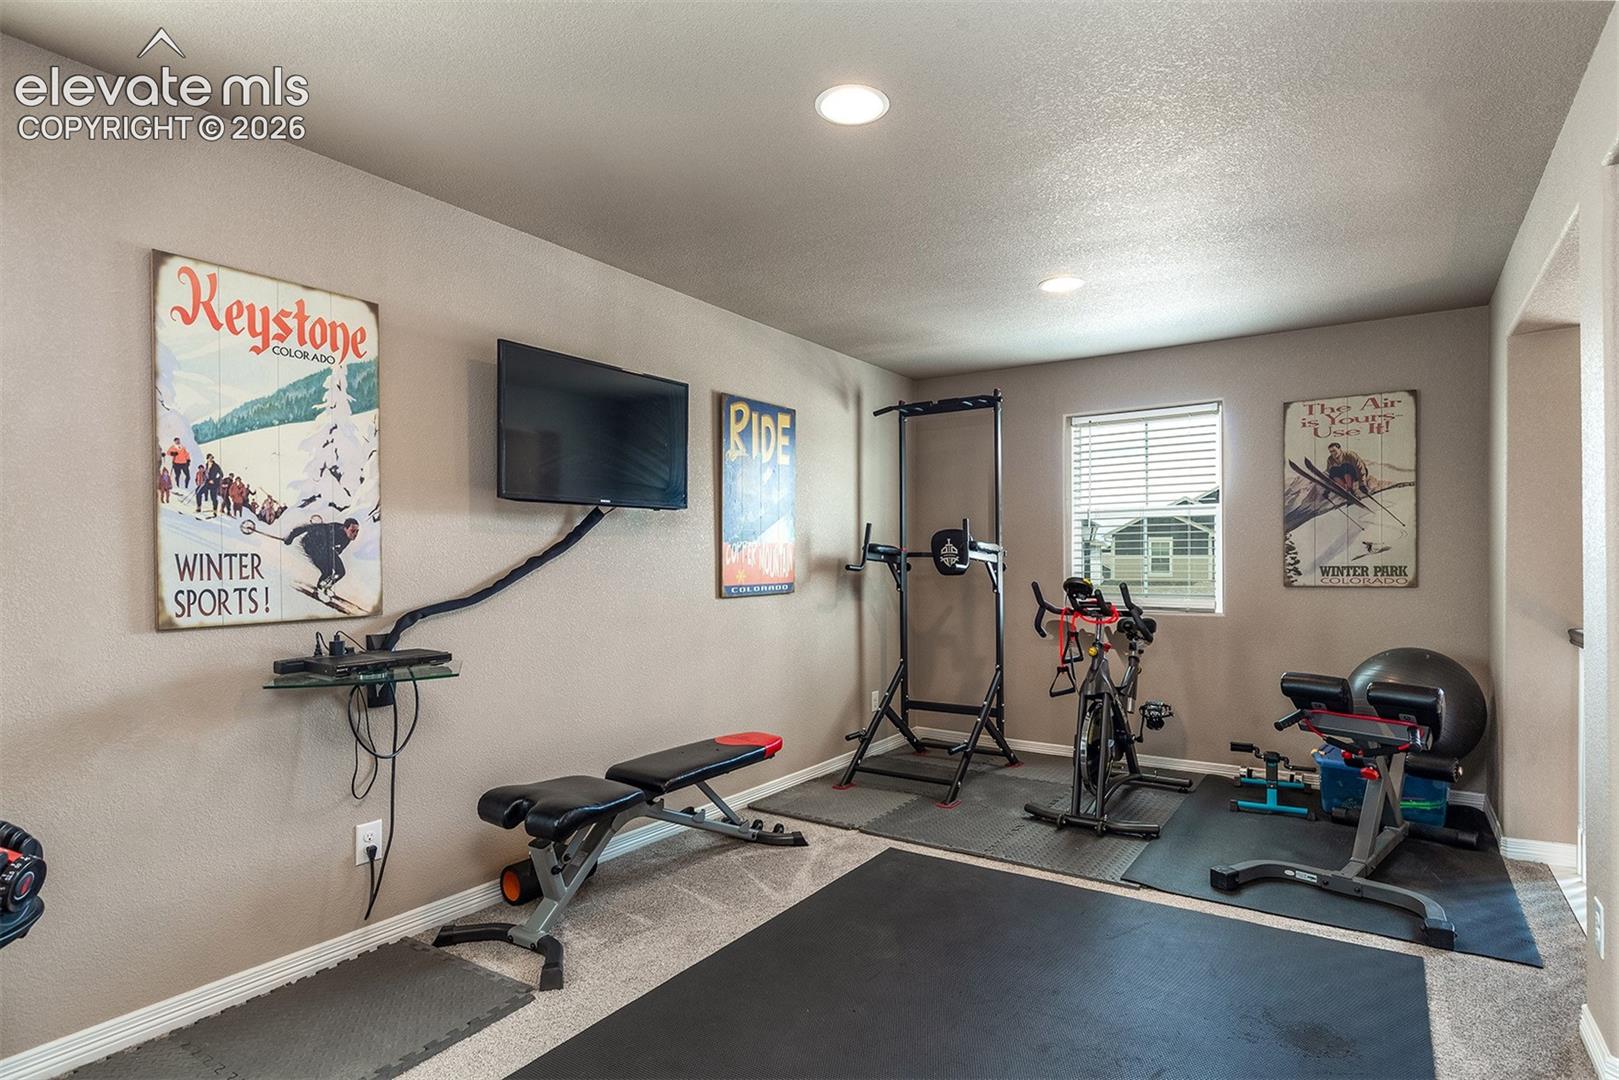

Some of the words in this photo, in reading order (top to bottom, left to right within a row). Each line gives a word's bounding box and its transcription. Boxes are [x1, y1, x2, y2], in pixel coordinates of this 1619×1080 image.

[169, 265, 368, 365] Keystone
[271, 345, 336, 365] COLORADO
[1303, 403, 1351, 415] The
[1360, 397, 1402, 411] Air
[1300, 417, 1320, 429] is
[1313, 426, 1361, 438] Use
[1368, 420, 1390, 435] It!
[726, 401, 791, 465] RIDE
[174, 552, 265, 582] WINTER
[1320, 565, 1369, 577] WINTER
[1373, 565, 1408, 577] PARK
[731, 584, 789, 594] COLORADO
[1320, 577, 1408, 585] COLORADO
